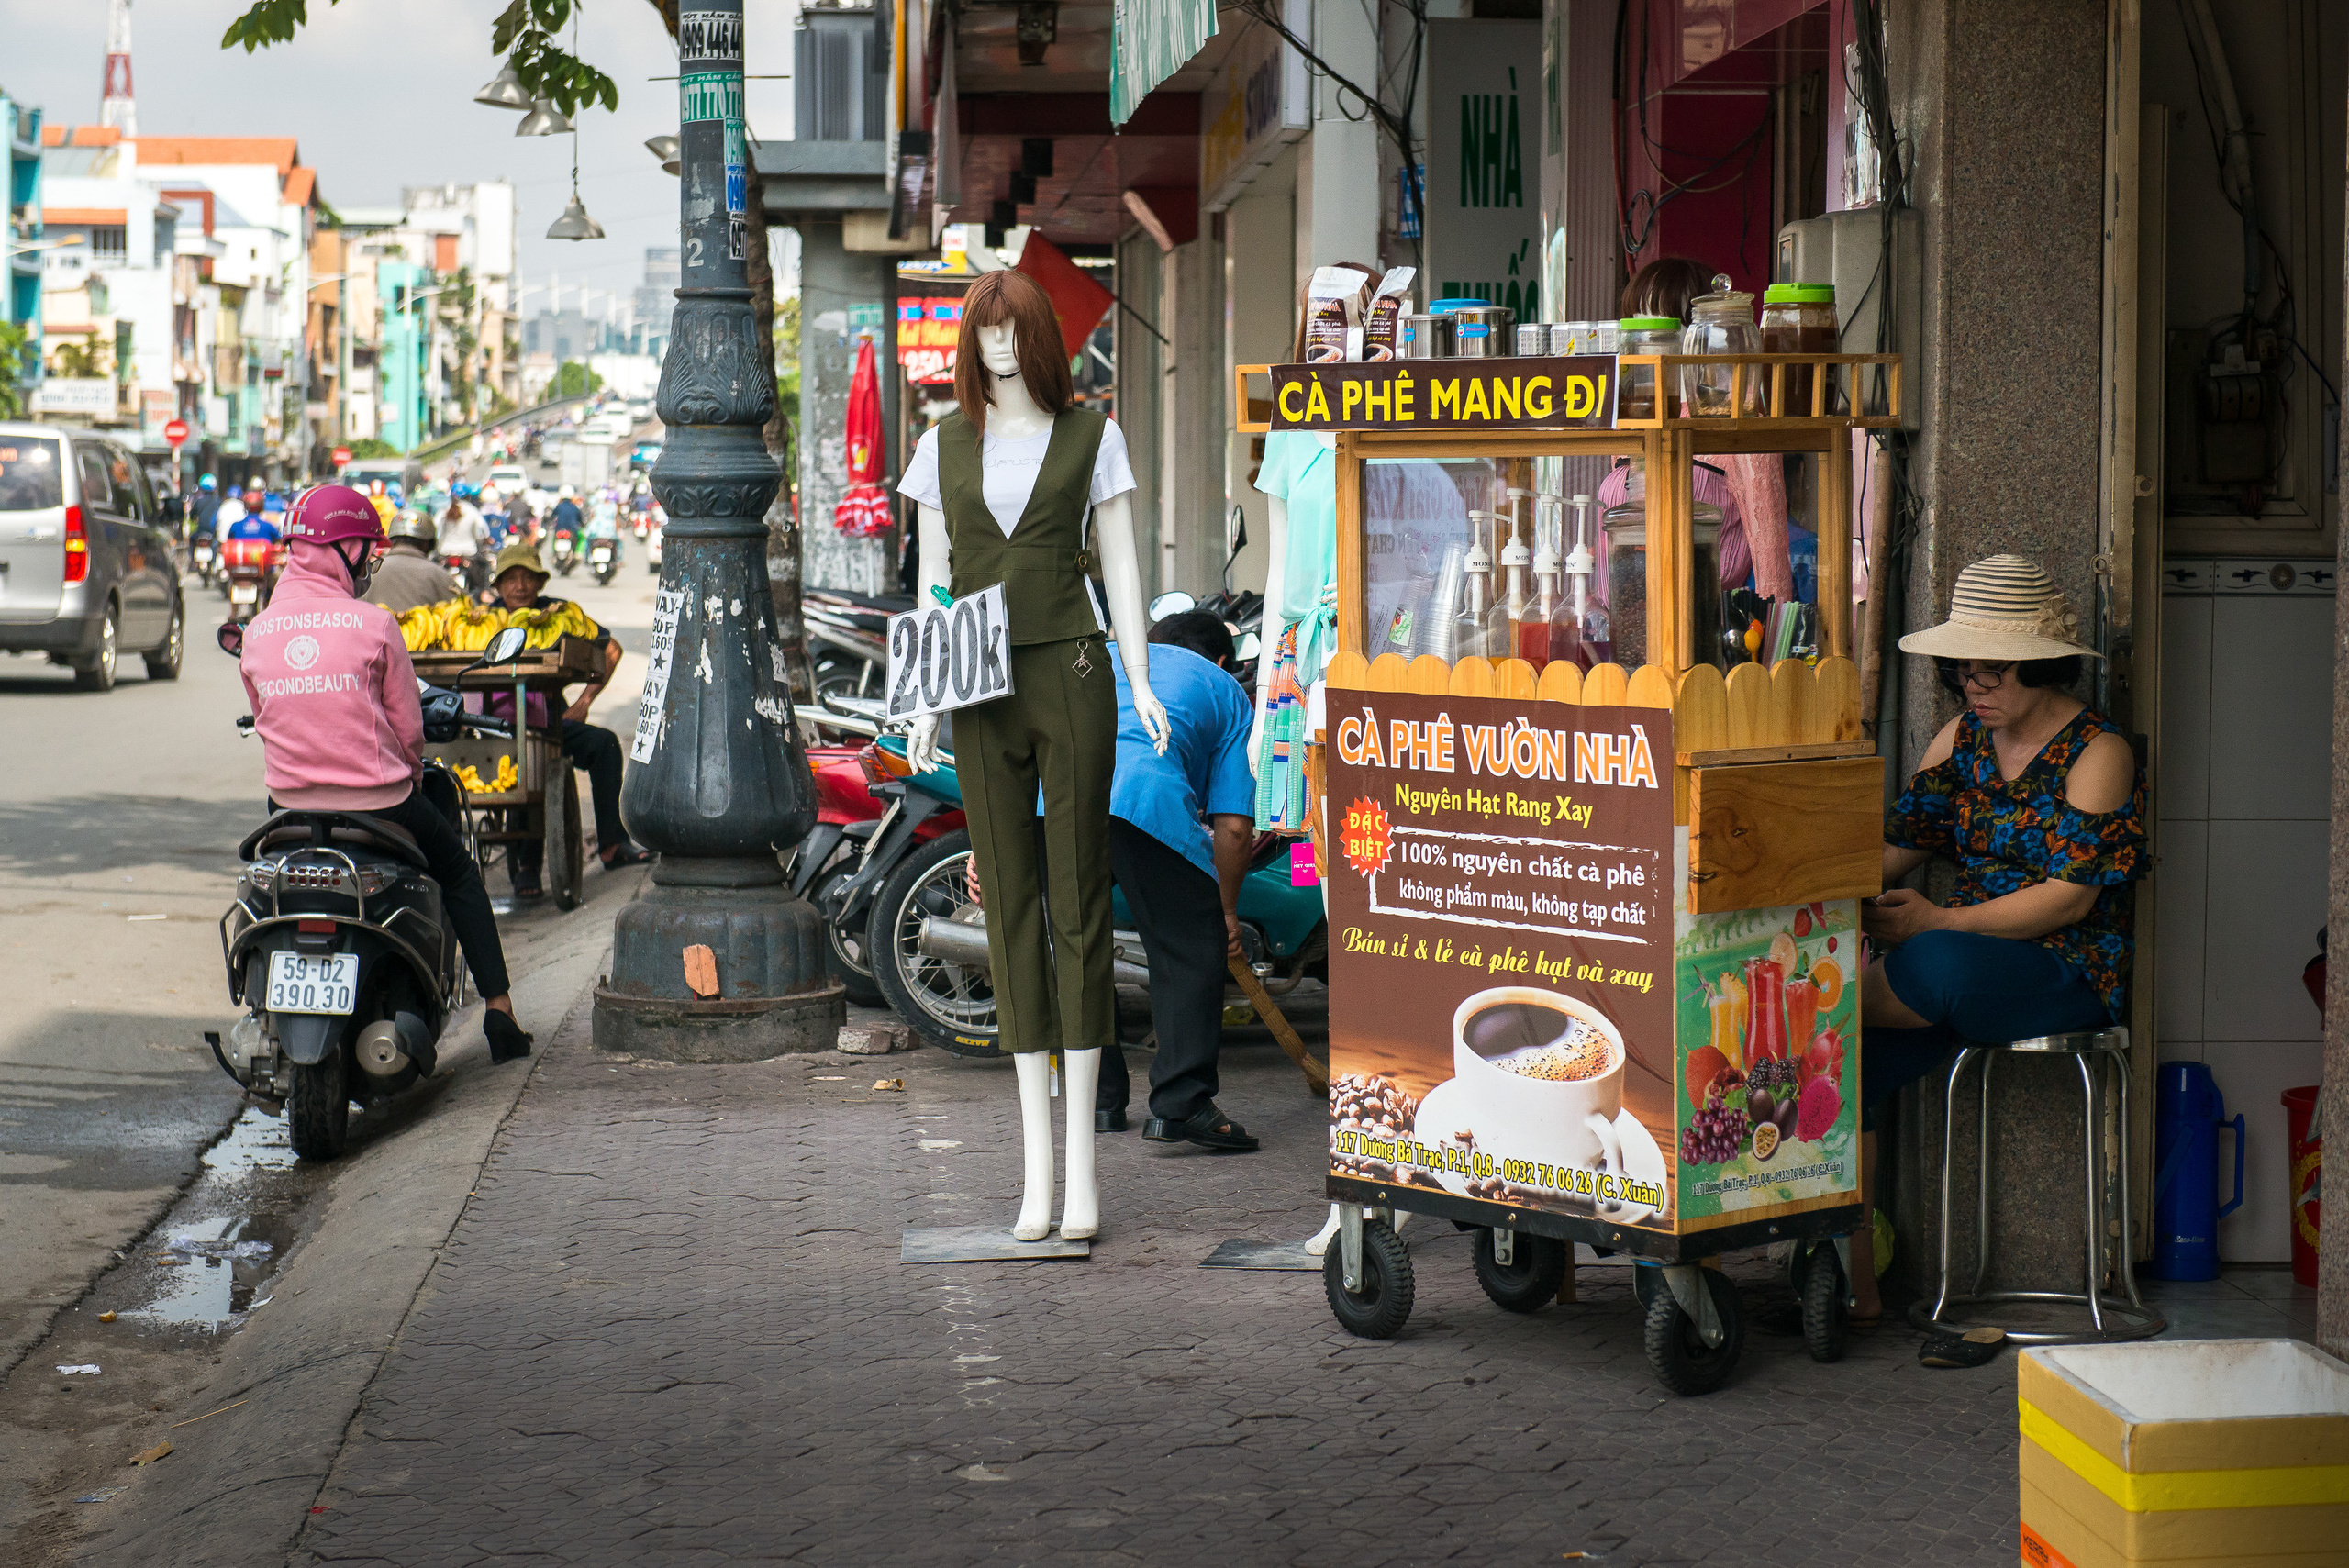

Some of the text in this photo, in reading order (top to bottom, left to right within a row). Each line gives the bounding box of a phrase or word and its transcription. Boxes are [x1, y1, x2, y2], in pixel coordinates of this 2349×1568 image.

[1460, 66, 1523, 208] NHÀ
[687, 238, 704, 268] 2
[1278, 369, 1607, 423] CÀ PHÊ MANG ĐI
[252, 612, 363, 640] BOSTONSEASON
[890, 593, 1006, 716] 200k
[257, 673, 360, 700] SECONDBEAUTY
[1337, 706, 1659, 789] CÀ PHÊ VƯỜN NHÀ
[1395, 783, 1593, 829] Nguyên Hạt Rang Xay
[1349, 810, 1383, 835] ĐẶC
[1350, 837, 1384, 862] BIỆT
[1401, 841, 1645, 890] 100% nguyên chất cà phê
[1399, 877, 1646, 927] không phẩm màu, không tạp chất
[284, 957, 345, 983] 59-D2
[1341, 927, 1654, 994] Bán sỉ & lẻ cà phê hạt và xay
[273, 984, 350, 1009] 390.30
[954, 1035, 991, 1047] MAXXIS
[1336, 1129, 1357, 1155] 117
[1360, 1134, 1395, 1164] Dương
[1397, 1139, 1413, 1164] Bá
[1415, 1141, 1445, 1173] Trạc,
[1447, 1147, 1471, 1179] P.1,
[1473, 1151, 1493, 1181] Q.8
[1504, 1158, 1536, 1185] 0932
[1538, 1162, 1554, 1188] 76
[1557, 1167, 1574, 1192] 06
[1576, 1170, 1593, 1195] 26
[1596, 1173, 1618, 1204] (C.
[1620, 1176, 1664, 1213] Xuân)
[1692, 1183, 1705, 1196] 117
[2023, 1533, 2049, 1563] KERRY
